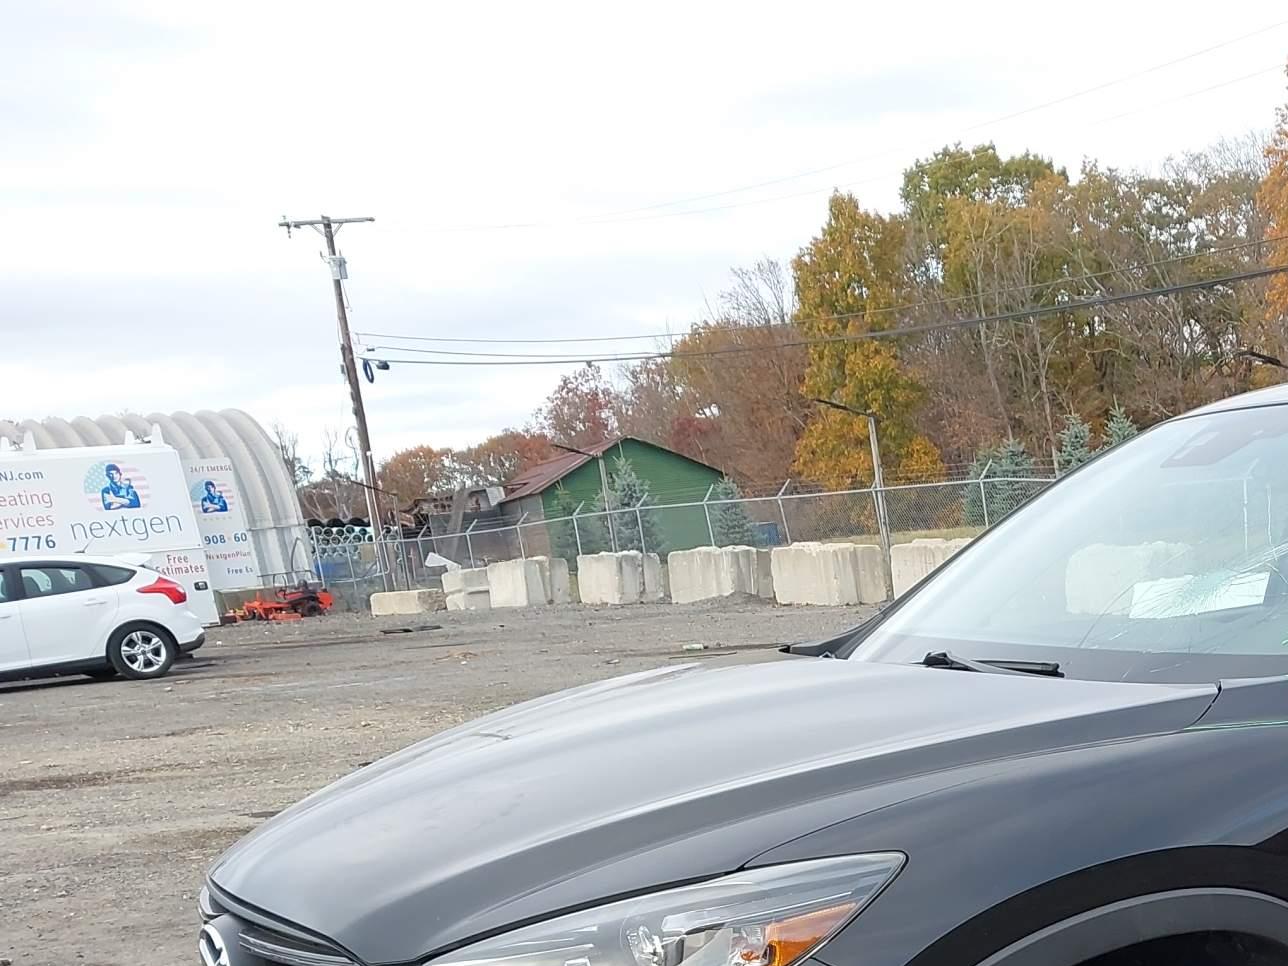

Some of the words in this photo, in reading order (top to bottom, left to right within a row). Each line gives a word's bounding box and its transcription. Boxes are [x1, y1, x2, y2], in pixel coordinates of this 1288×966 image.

[69, 513, 183, 541] nextgen
[7, 534, 56, 552] 7776
[204, 534, 227, 545] 908
[166, 554, 189, 564] Free
